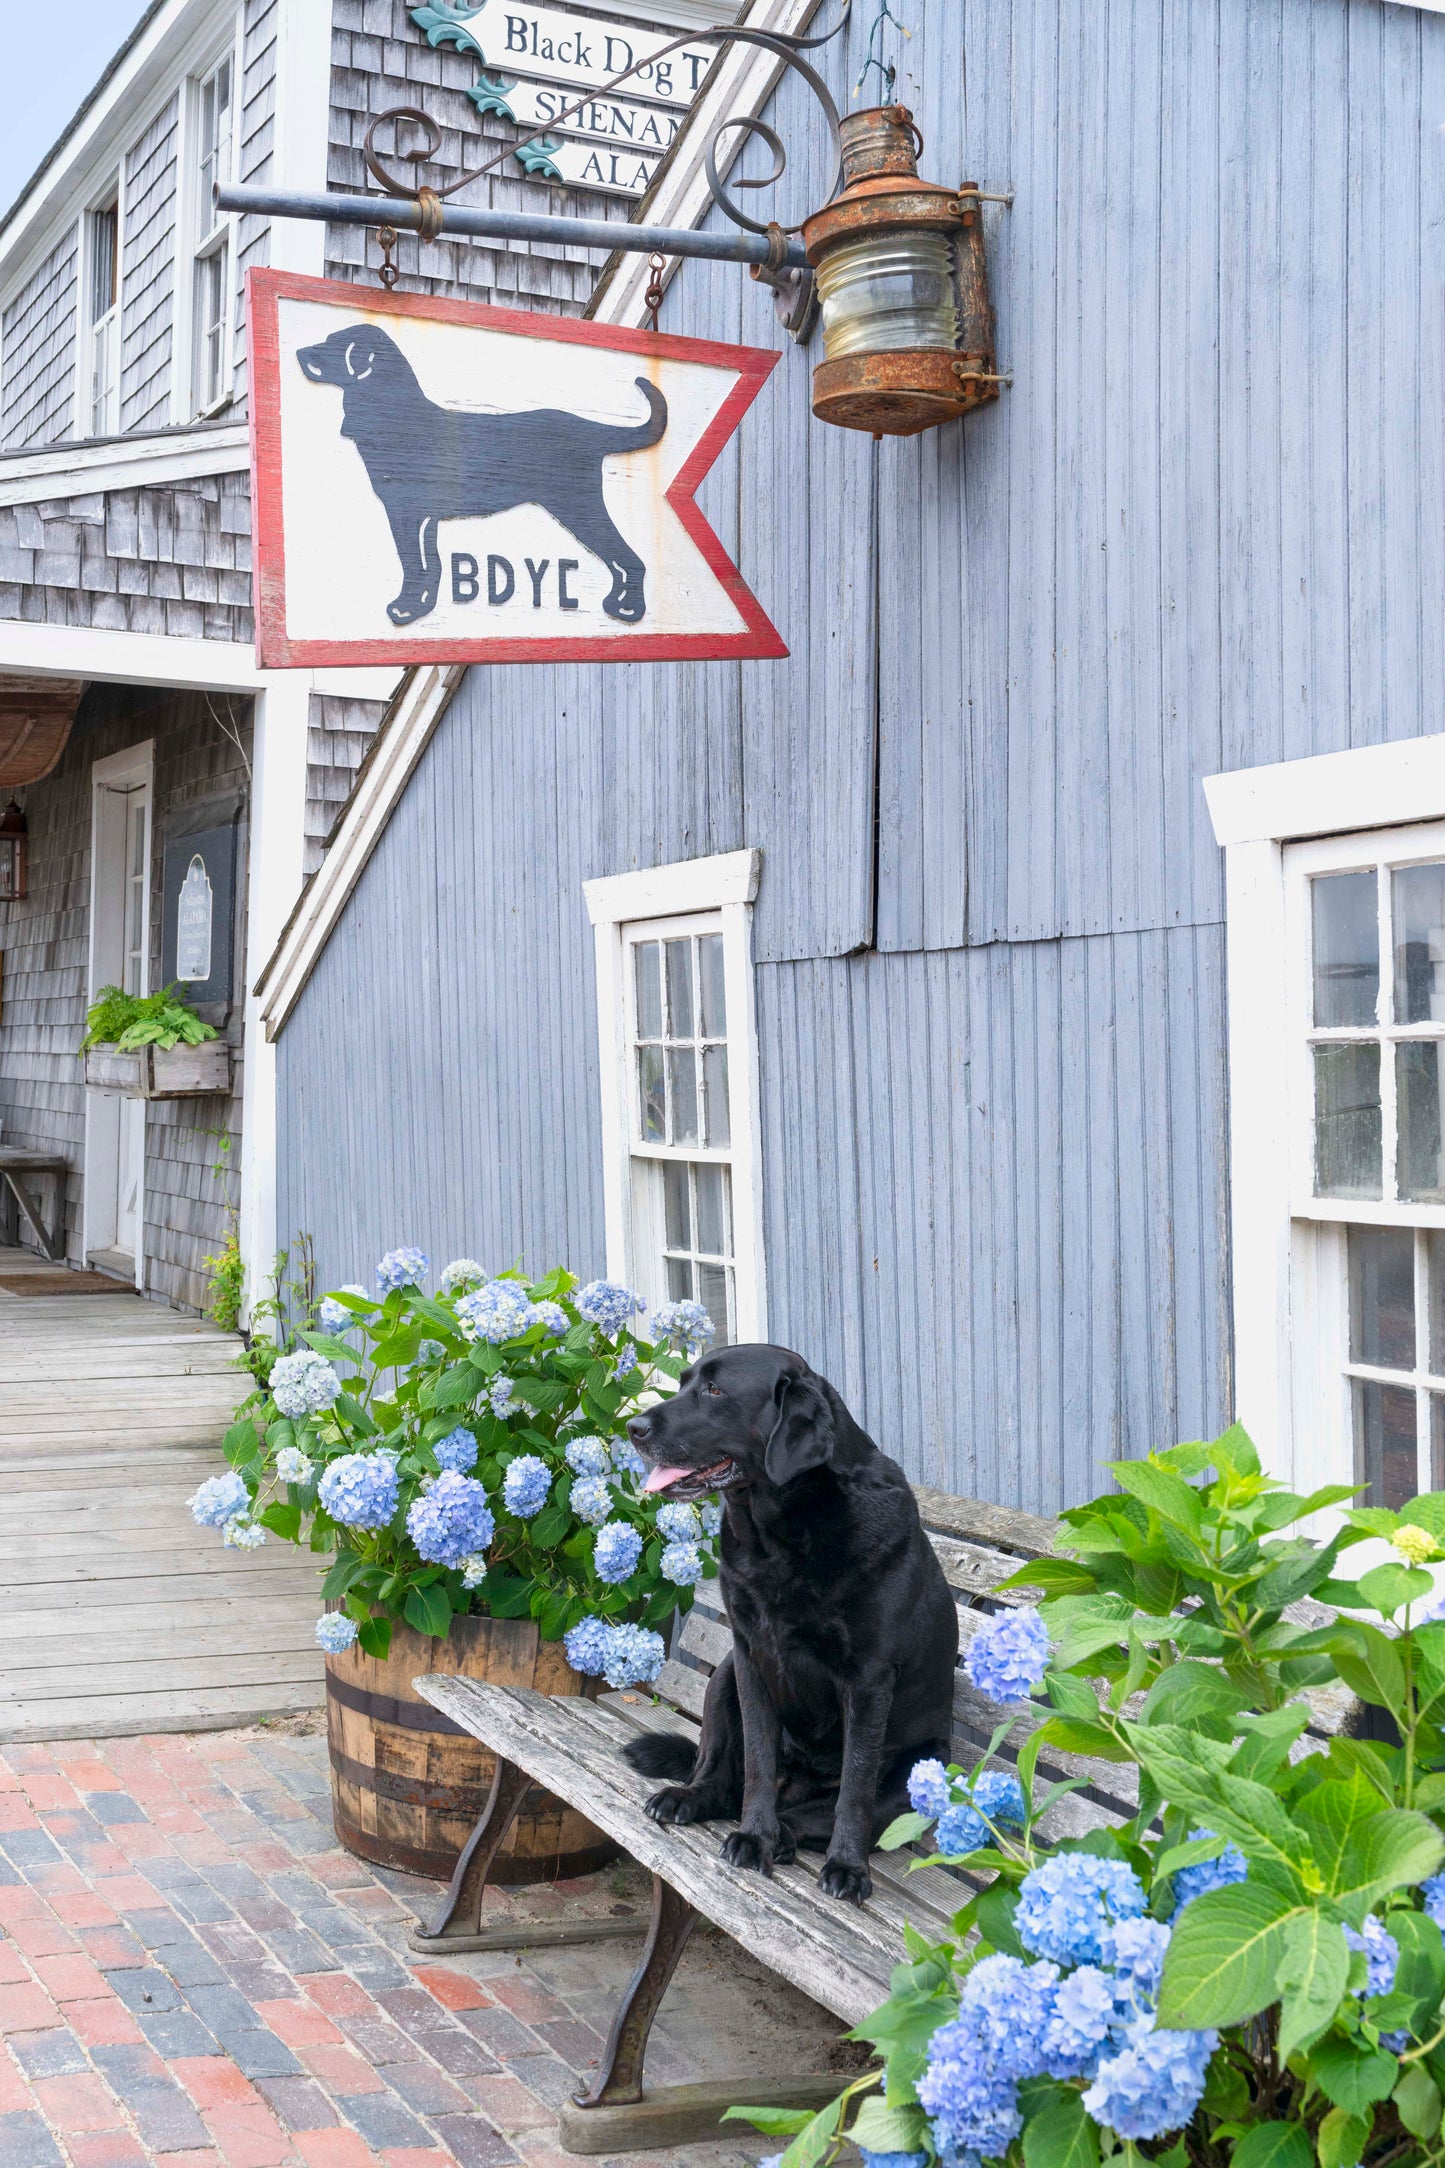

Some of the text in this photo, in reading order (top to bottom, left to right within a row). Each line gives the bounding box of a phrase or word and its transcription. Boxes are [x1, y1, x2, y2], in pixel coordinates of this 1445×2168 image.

[504, 14, 710, 96] Black Dog T
[580, 151, 650, 189] ALA
[451, 552, 579, 609] BDYC
